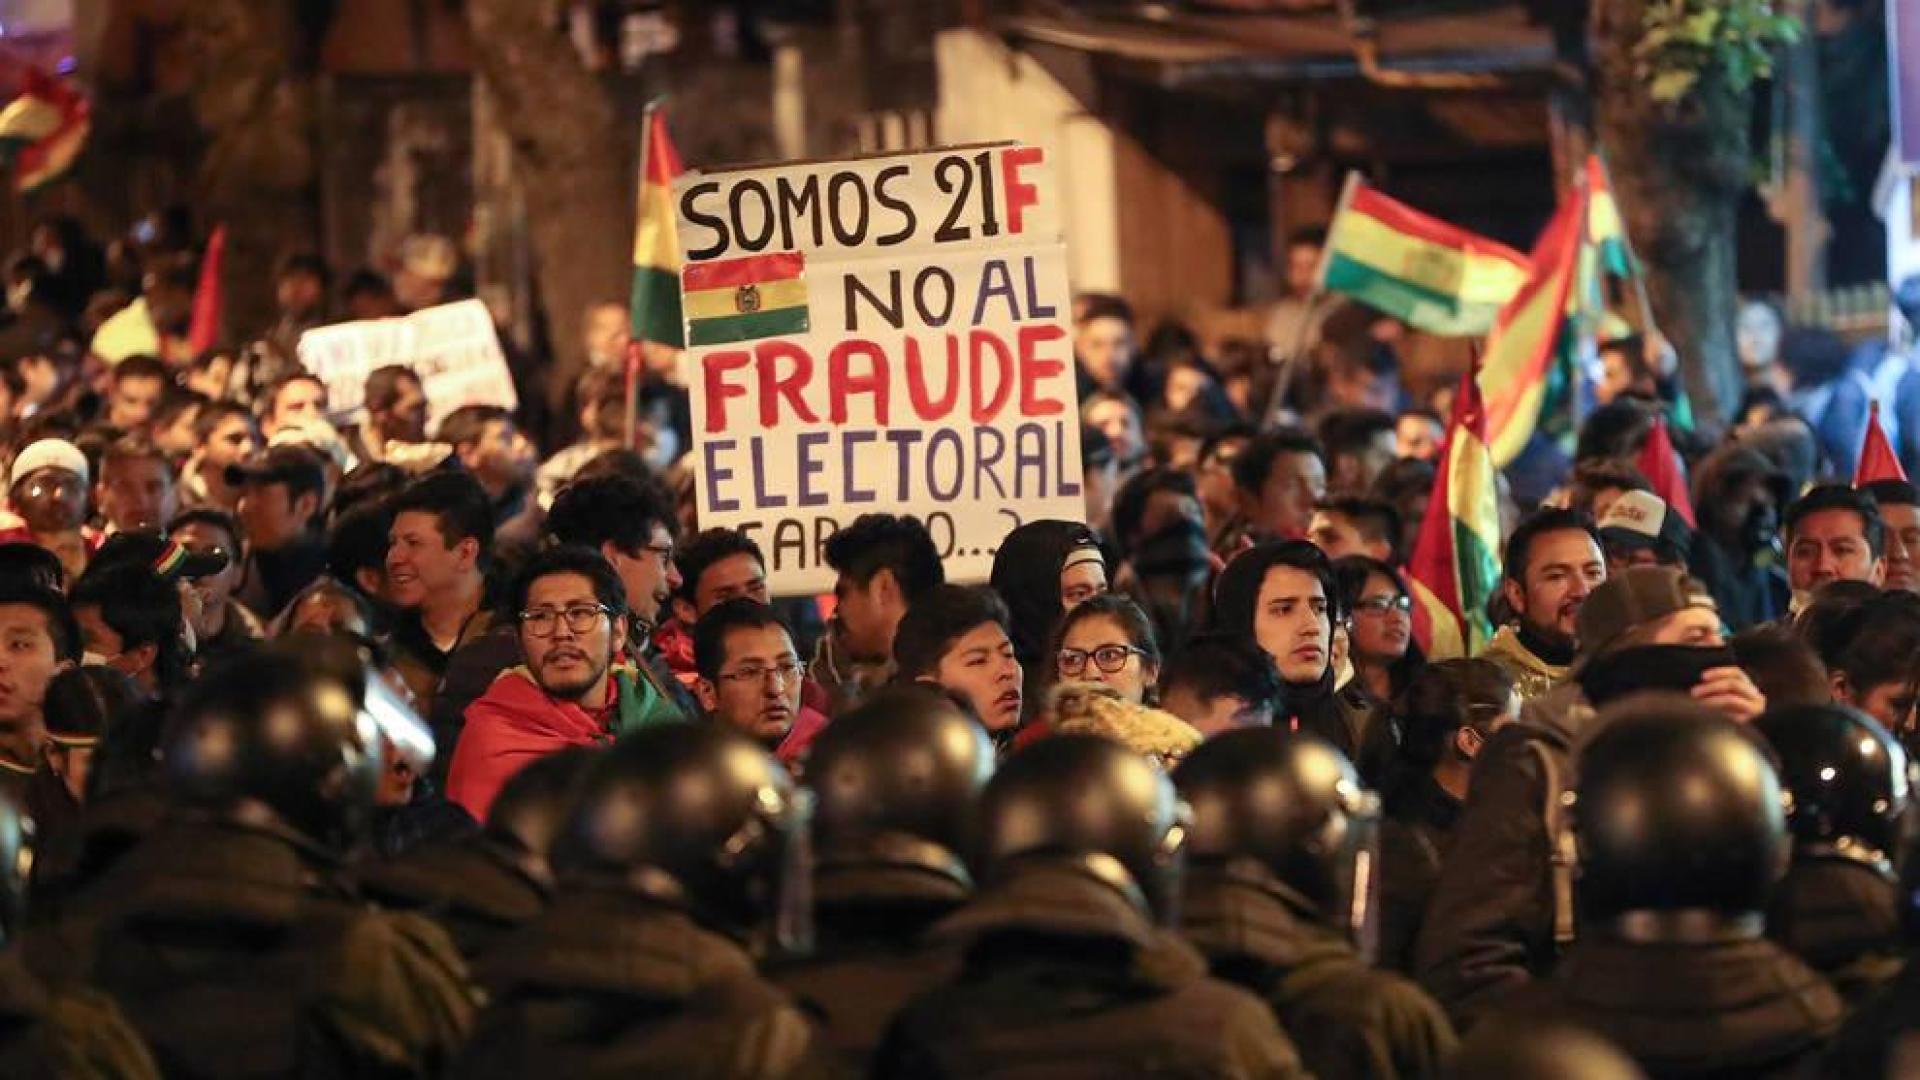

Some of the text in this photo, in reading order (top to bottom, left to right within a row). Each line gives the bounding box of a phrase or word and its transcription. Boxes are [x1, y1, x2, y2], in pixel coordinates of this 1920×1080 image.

[679, 147, 1044, 261] SOMOS 21F
[843, 256, 1057, 332] NO AL
[702, 324, 1067, 434] FRAUDE
[703, 420, 1082, 513] ELECTORAL
